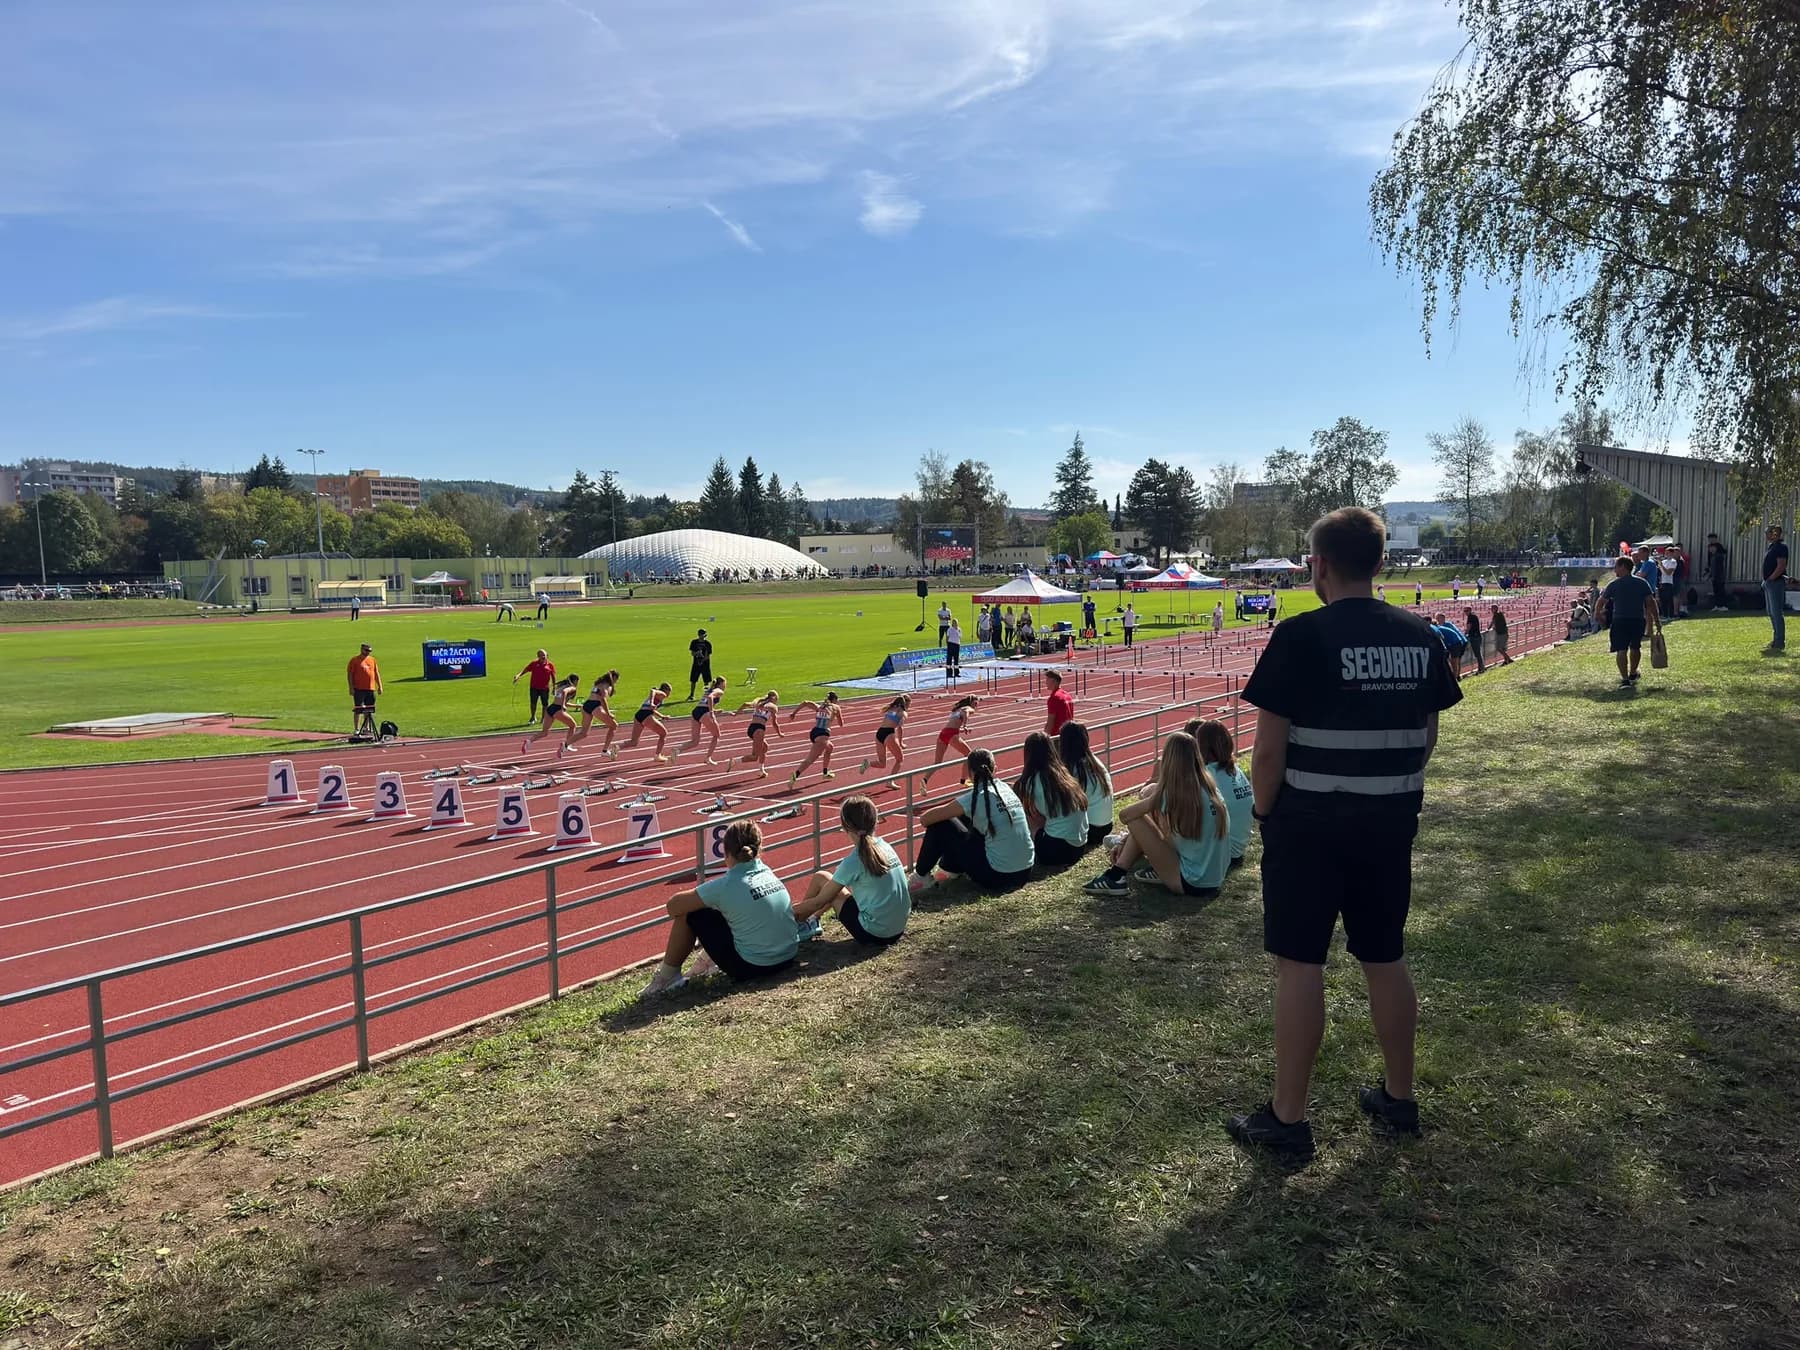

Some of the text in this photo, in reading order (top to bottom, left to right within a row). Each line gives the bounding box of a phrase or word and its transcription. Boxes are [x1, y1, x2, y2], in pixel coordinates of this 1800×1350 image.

[1341, 646, 1430, 680] SECURITY
[274, 769, 288, 794] 1
[323, 775, 343, 802] 2
[380, 781, 399, 809] 3
[436, 788, 458, 816] 4
[502, 795, 523, 826] 5
[562, 805, 584, 836] 6
[632, 814, 653, 847] 7
[712, 825, 729, 858] 8
